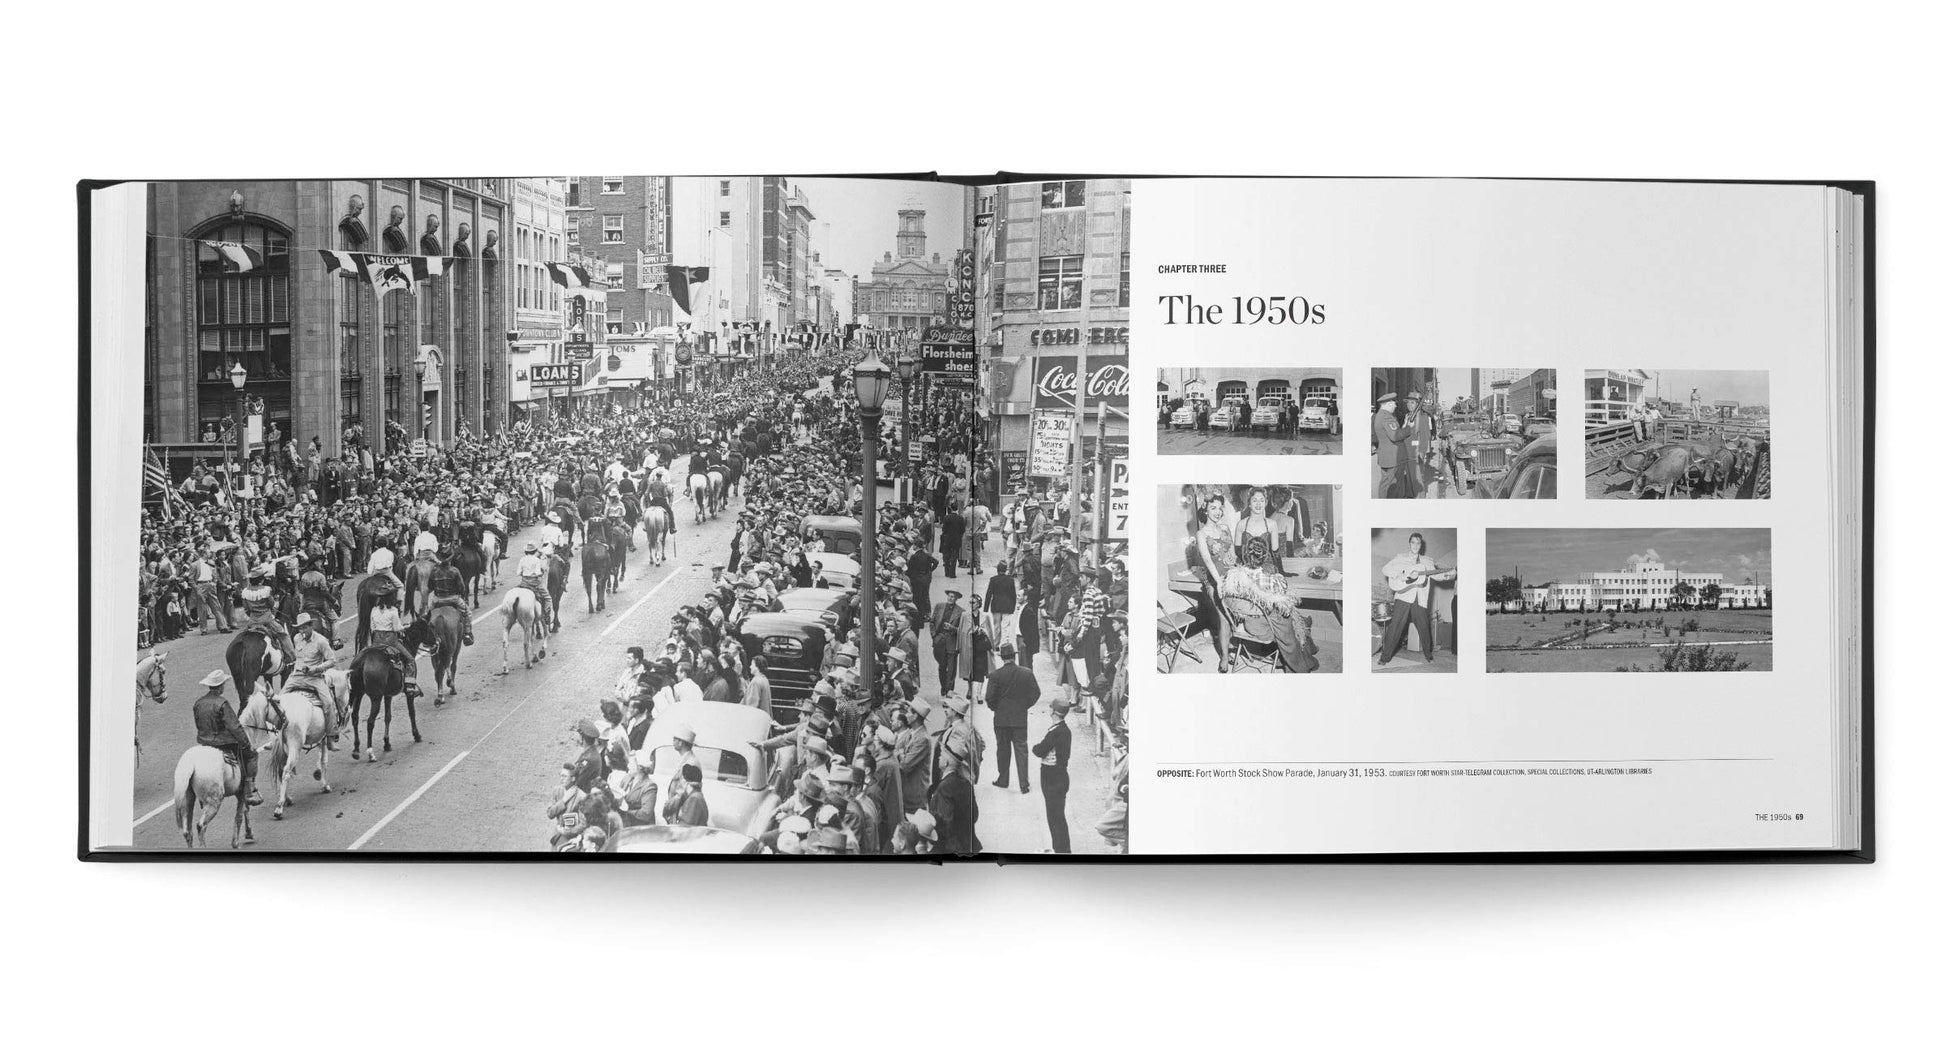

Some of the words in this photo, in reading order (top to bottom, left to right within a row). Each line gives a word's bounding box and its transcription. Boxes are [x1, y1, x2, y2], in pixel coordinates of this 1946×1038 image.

[1158, 265, 1197, 274] CHAPTER
[1199, 264, 1226, 273] THREE
[1159, 295, 1223, 325] The
[1232, 296, 1325, 325] 1950s
[923, 345, 973, 359] Florsheim
[532, 366, 579, 381] LOANS
[1157, 768, 1194, 777] OPPOSITE:
[1196, 769, 1212, 777] Fort
[1213, 769, 1236, 777] Worth
[1238, 769, 1261, 777] Stock
[1262, 768, 1284, 777] Show
[1286, 769, 1315, 778] Parade,
[1317, 769, 1347, 778] January
[1349, 768, 1361, 778] 31,
[1364, 768, 1387, 777] 1953.
